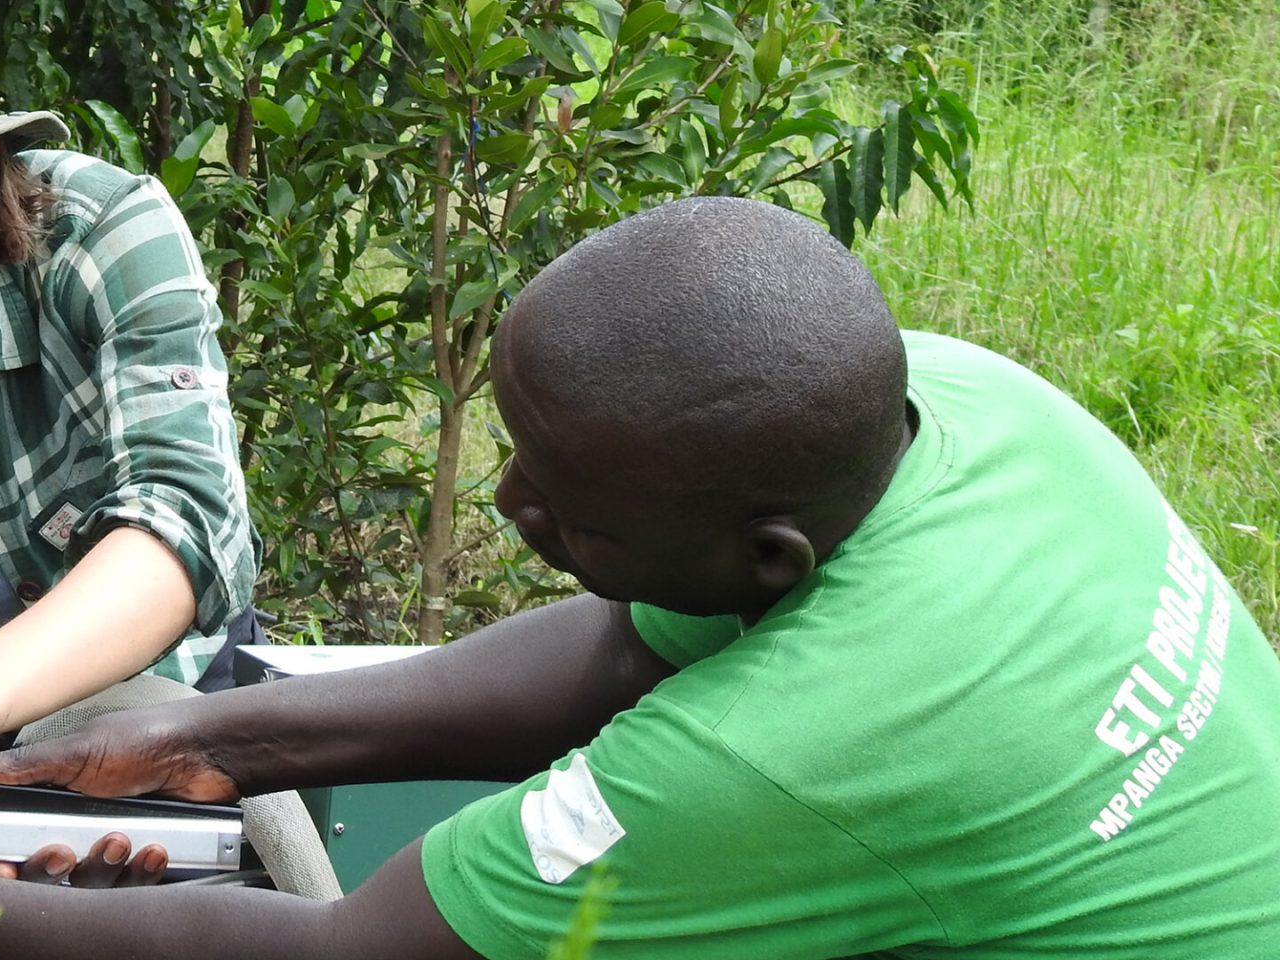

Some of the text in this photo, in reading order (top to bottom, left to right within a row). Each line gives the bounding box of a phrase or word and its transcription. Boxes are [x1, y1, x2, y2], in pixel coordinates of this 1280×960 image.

[1094, 499, 1207, 757] ETI PROJEC
[1089, 735, 1185, 841] MPANGA
